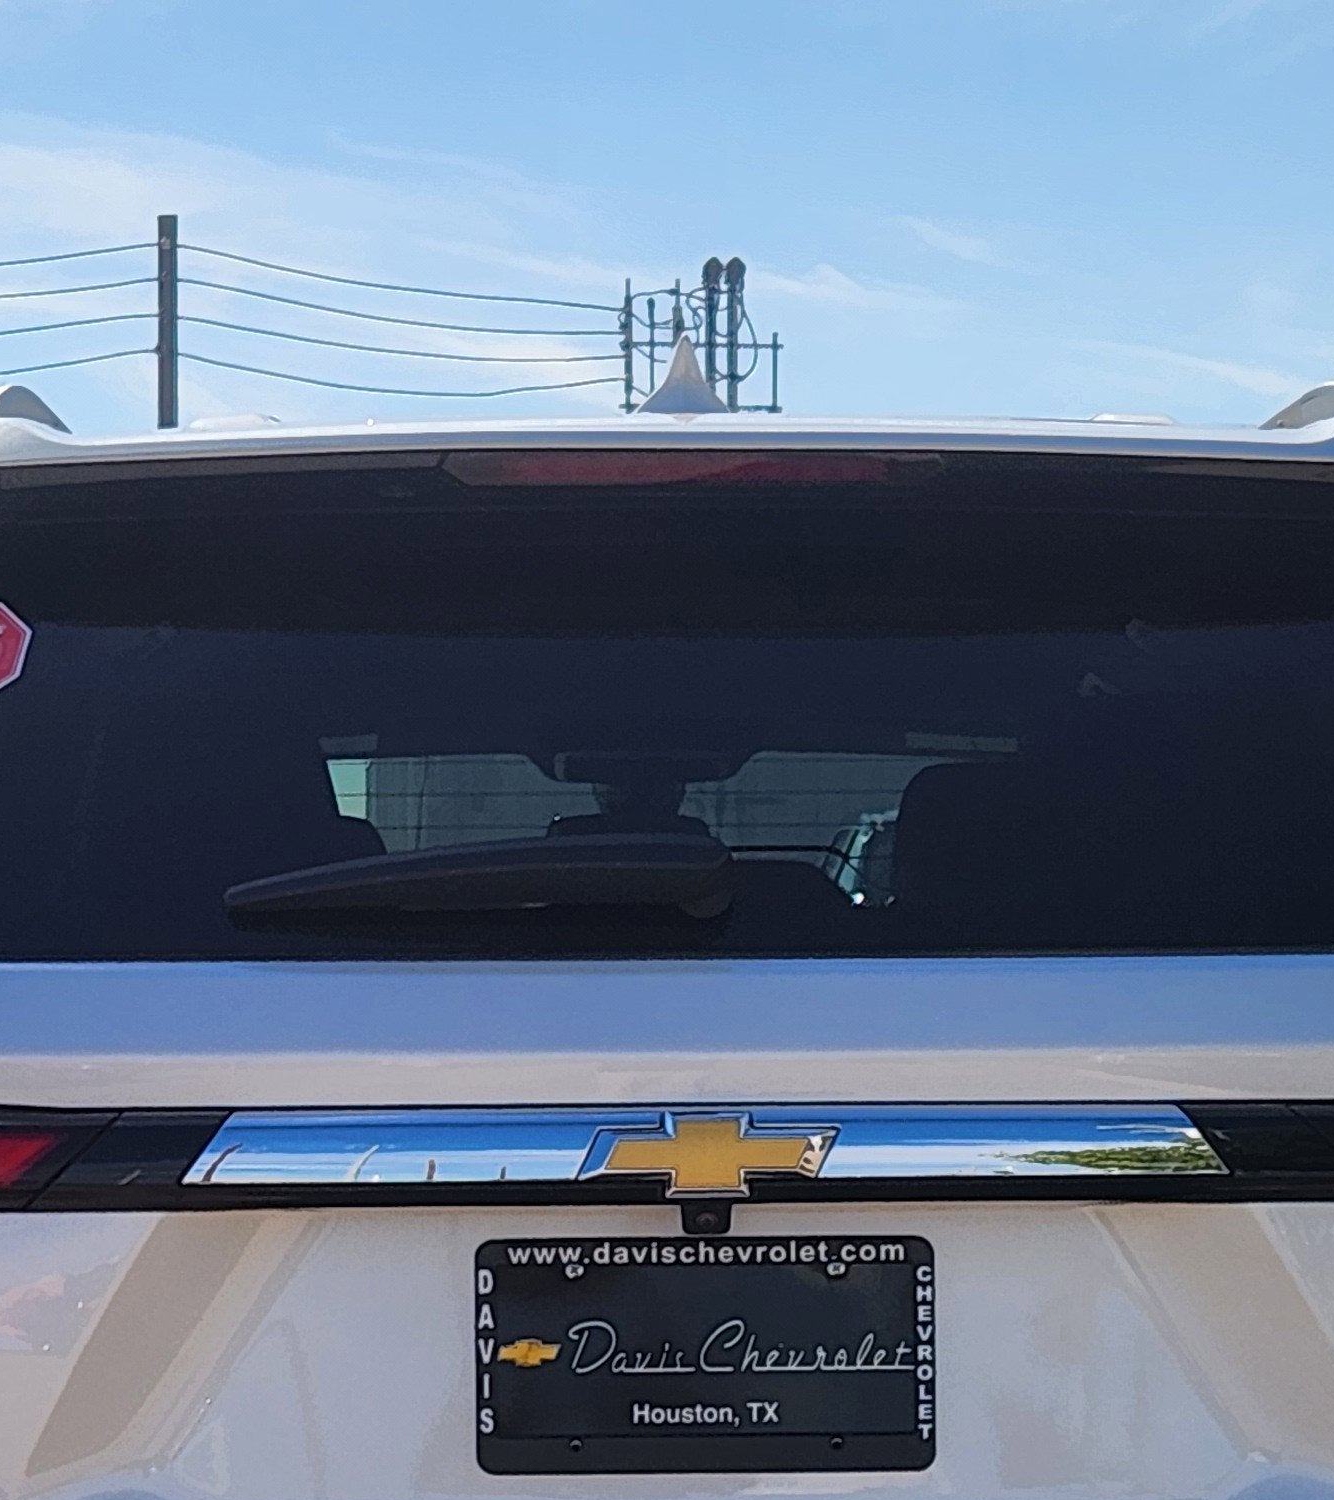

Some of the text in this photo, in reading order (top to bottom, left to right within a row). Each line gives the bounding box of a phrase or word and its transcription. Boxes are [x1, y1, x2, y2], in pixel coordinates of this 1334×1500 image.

[508, 1240, 905, 1264] www.davischevrolet.com
[478, 1269, 495, 1434] DAVIS
[568, 1319, 915, 1373] Davis Chevrolet
[916, 1265, 933, 1440] CHEVROLET
[633, 1402, 779, 1427] Houston, TX
